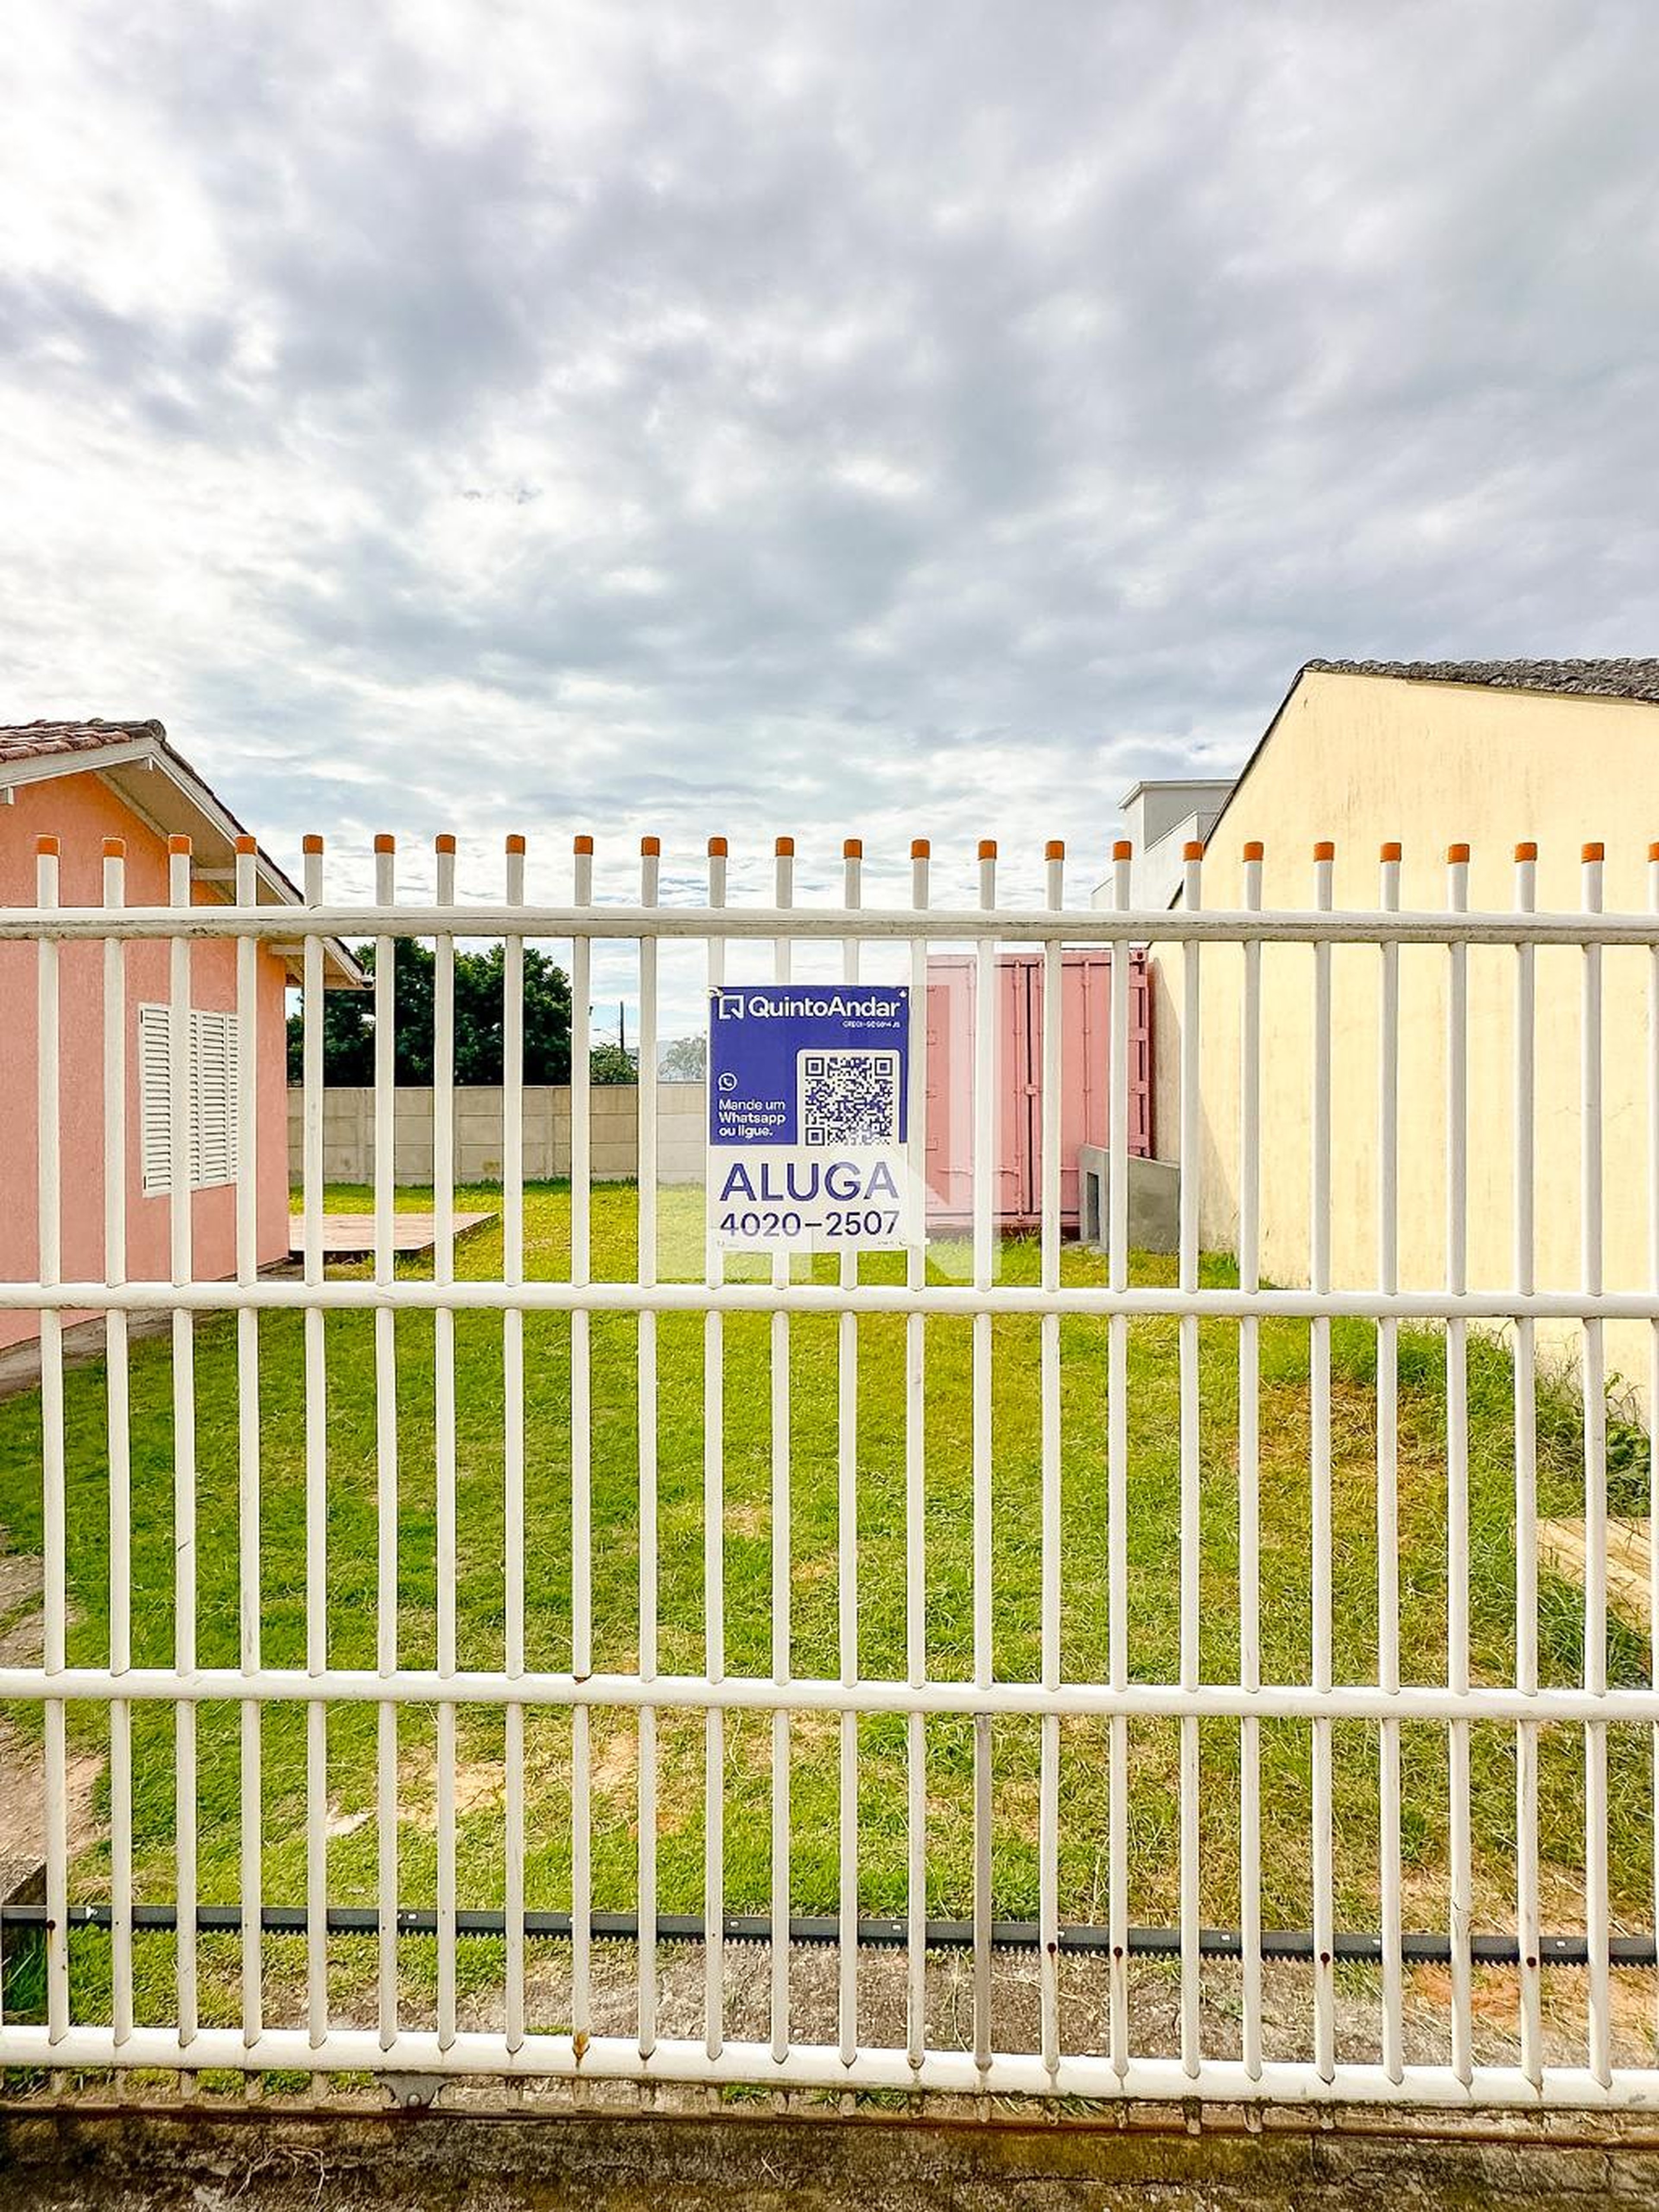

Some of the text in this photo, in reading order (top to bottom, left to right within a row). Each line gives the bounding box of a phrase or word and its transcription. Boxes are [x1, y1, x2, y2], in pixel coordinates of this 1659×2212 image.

[748, 996, 901, 1018] QuintoAndar
[718, 1099, 786, 1111] Mande um
[718, 1111, 786, 1126] Whatsapp
[718, 1124, 773, 1139] ou ligue.
[719, 1161, 899, 1201] ALUGA
[720, 1210, 900, 1237] 4020-2507
